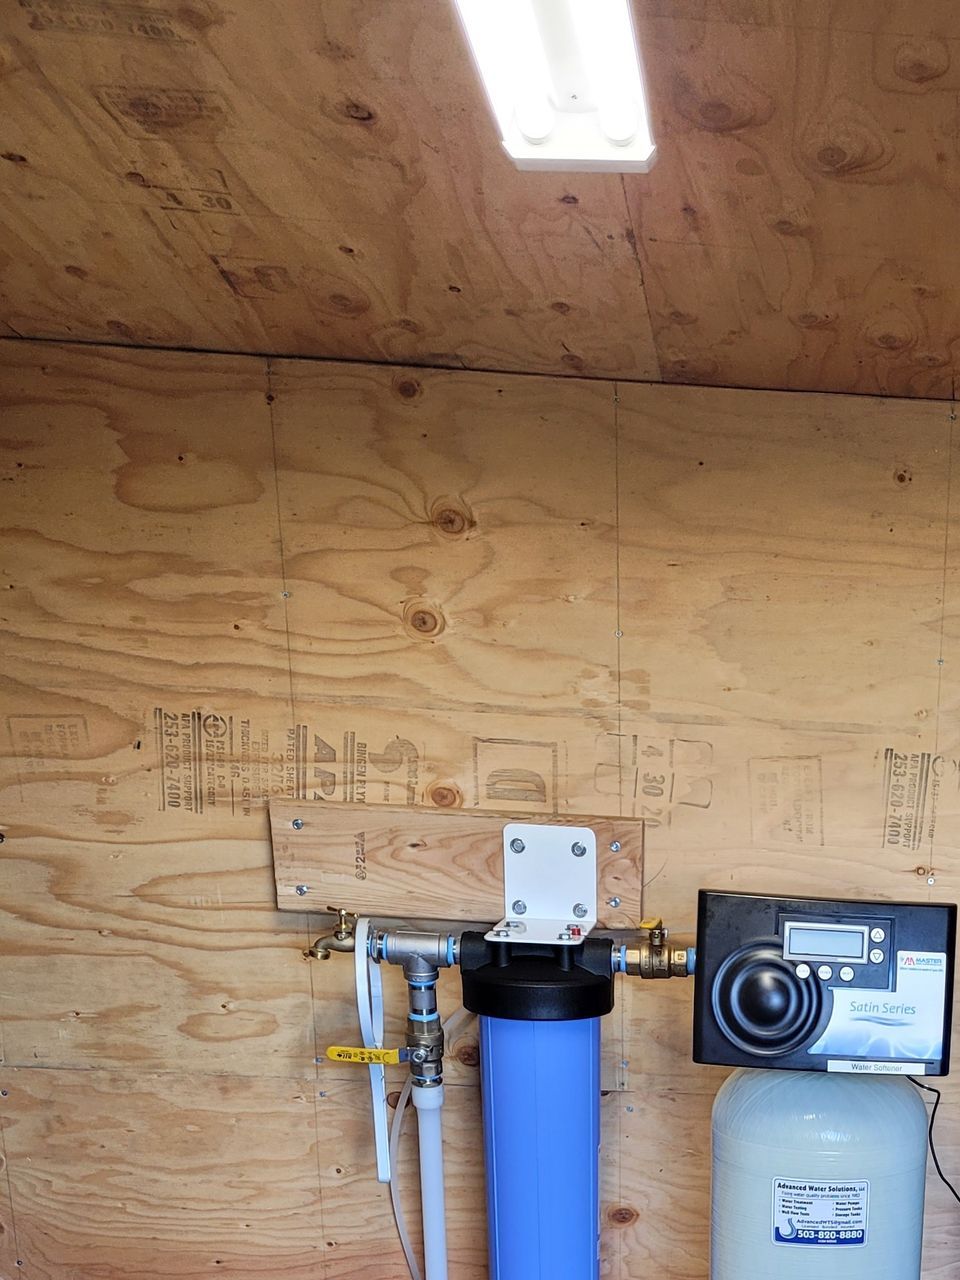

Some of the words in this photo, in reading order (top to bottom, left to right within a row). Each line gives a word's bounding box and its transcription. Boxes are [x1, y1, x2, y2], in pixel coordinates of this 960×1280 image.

[199, 195, 232, 210] 30
[181, 712, 192, 731] APA
[182, 732, 193, 772] PRODUCT
[240, 718, 250, 773] THICKNESS
[641, 745, 664, 759] 4
[163, 712, 182, 809] 253-620-7400
[313, 733, 337, 801] AP
[356, 741, 367, 780] BINGEN
[909, 752, 920, 770] APA
[183, 773, 194, 812] SUPPORT
[286, 766, 295, 799] SHEAT
[641, 772, 666, 798] 30
[905, 772, 918, 810] PRODUCT
[886, 752, 909, 846] 253-620-7400
[902, 812, 914, 849] SUPPORT
[915, 957, 943, 965] MASTER
[849, 1000, 880, 1014] Satin
[881, 1002, 917, 1015] Series
[851, 1062, 873, 1072] Water
[777, 1182, 807, 1192] Advanced
[828, 1185, 858, 1193] Solutions,
[797, 1230, 863, 1239] 503-820-8880
